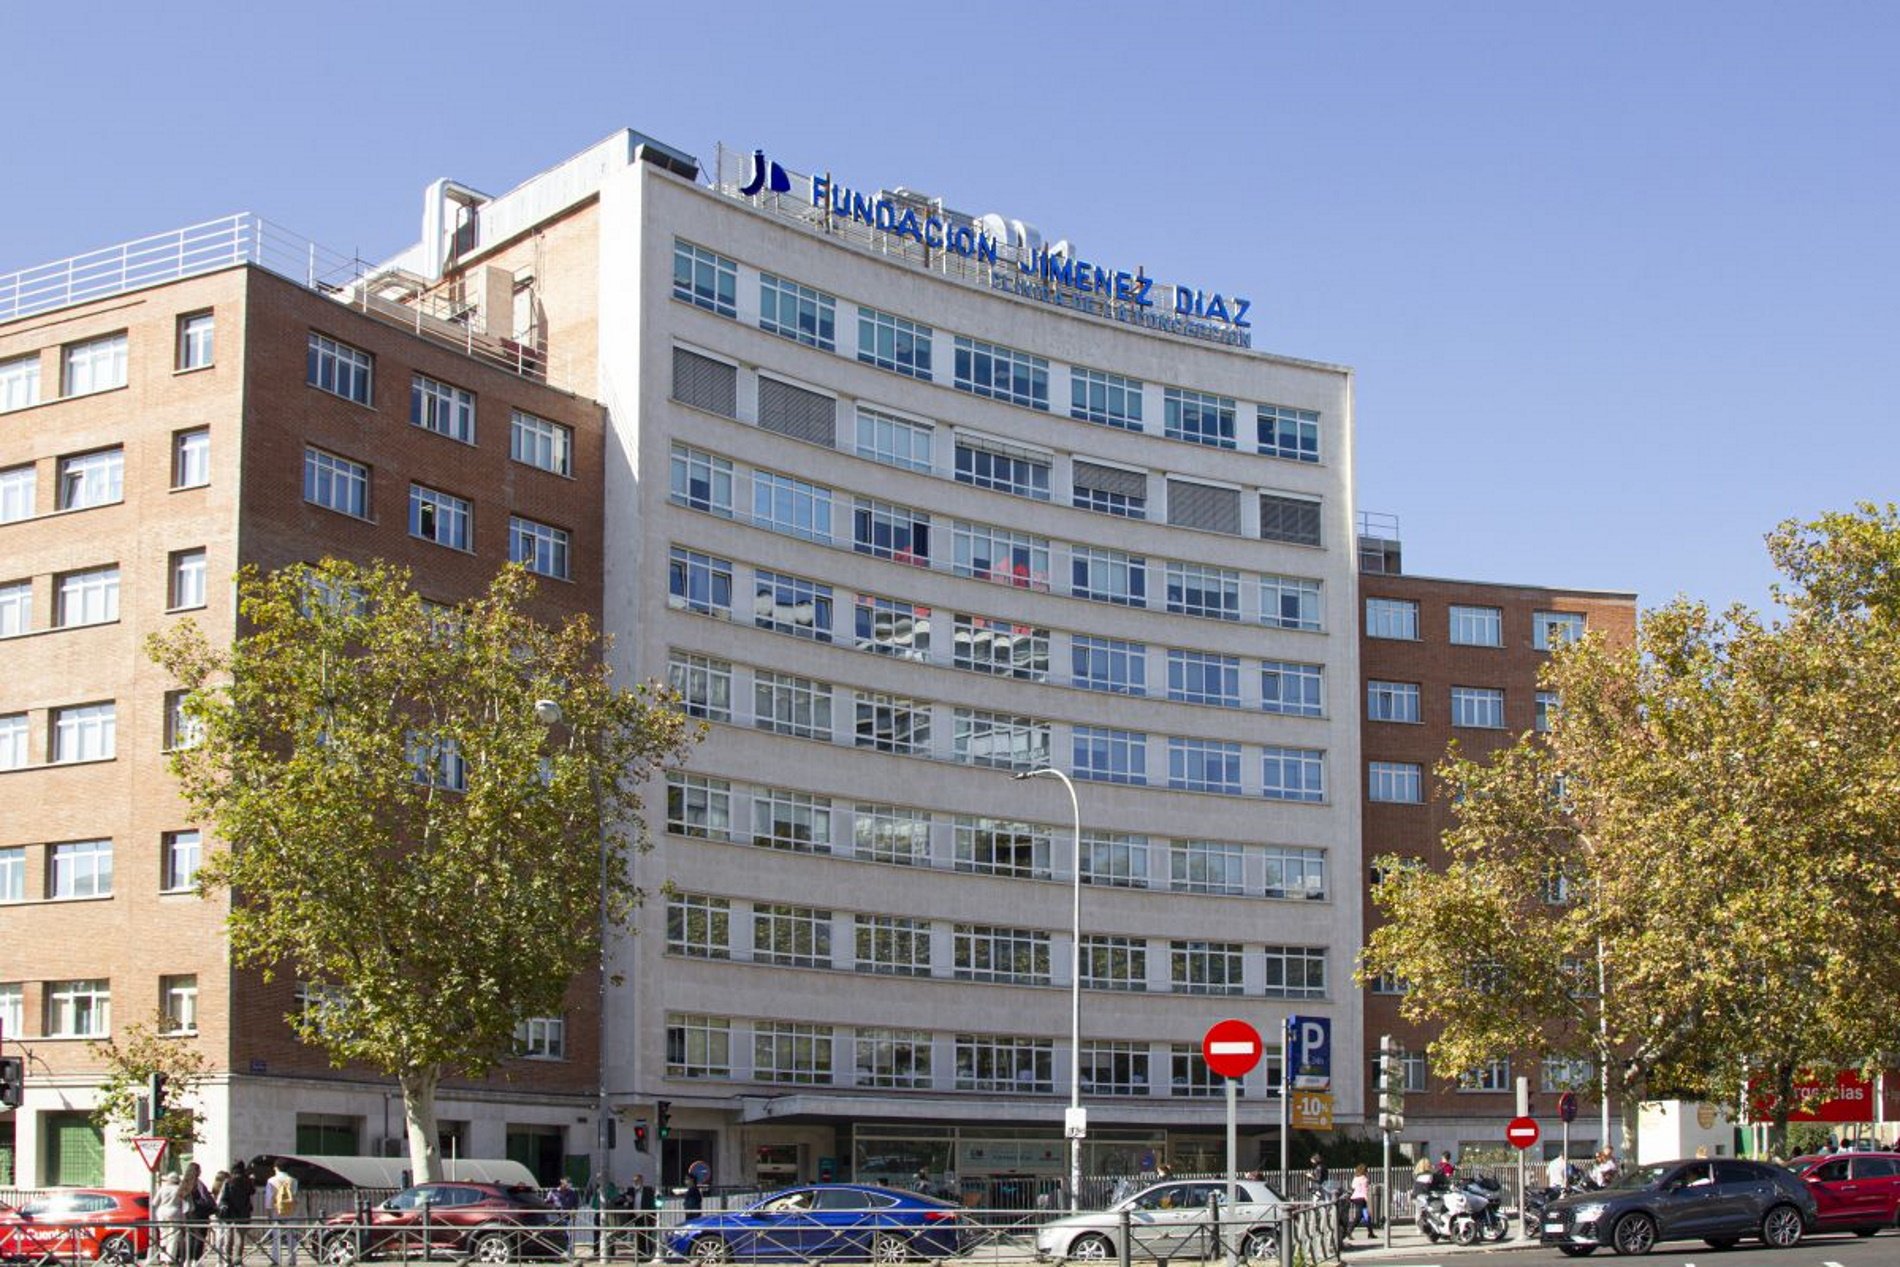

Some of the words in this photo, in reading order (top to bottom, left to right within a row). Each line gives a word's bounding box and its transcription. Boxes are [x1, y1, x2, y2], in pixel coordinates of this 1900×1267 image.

[810, 173, 998, 266] FUNDACION
[1017, 247, 1154, 308] JIMENEZ
[1173, 284, 1251, 328] DIAZ
[1302, 1022, 1324, 1066] P
